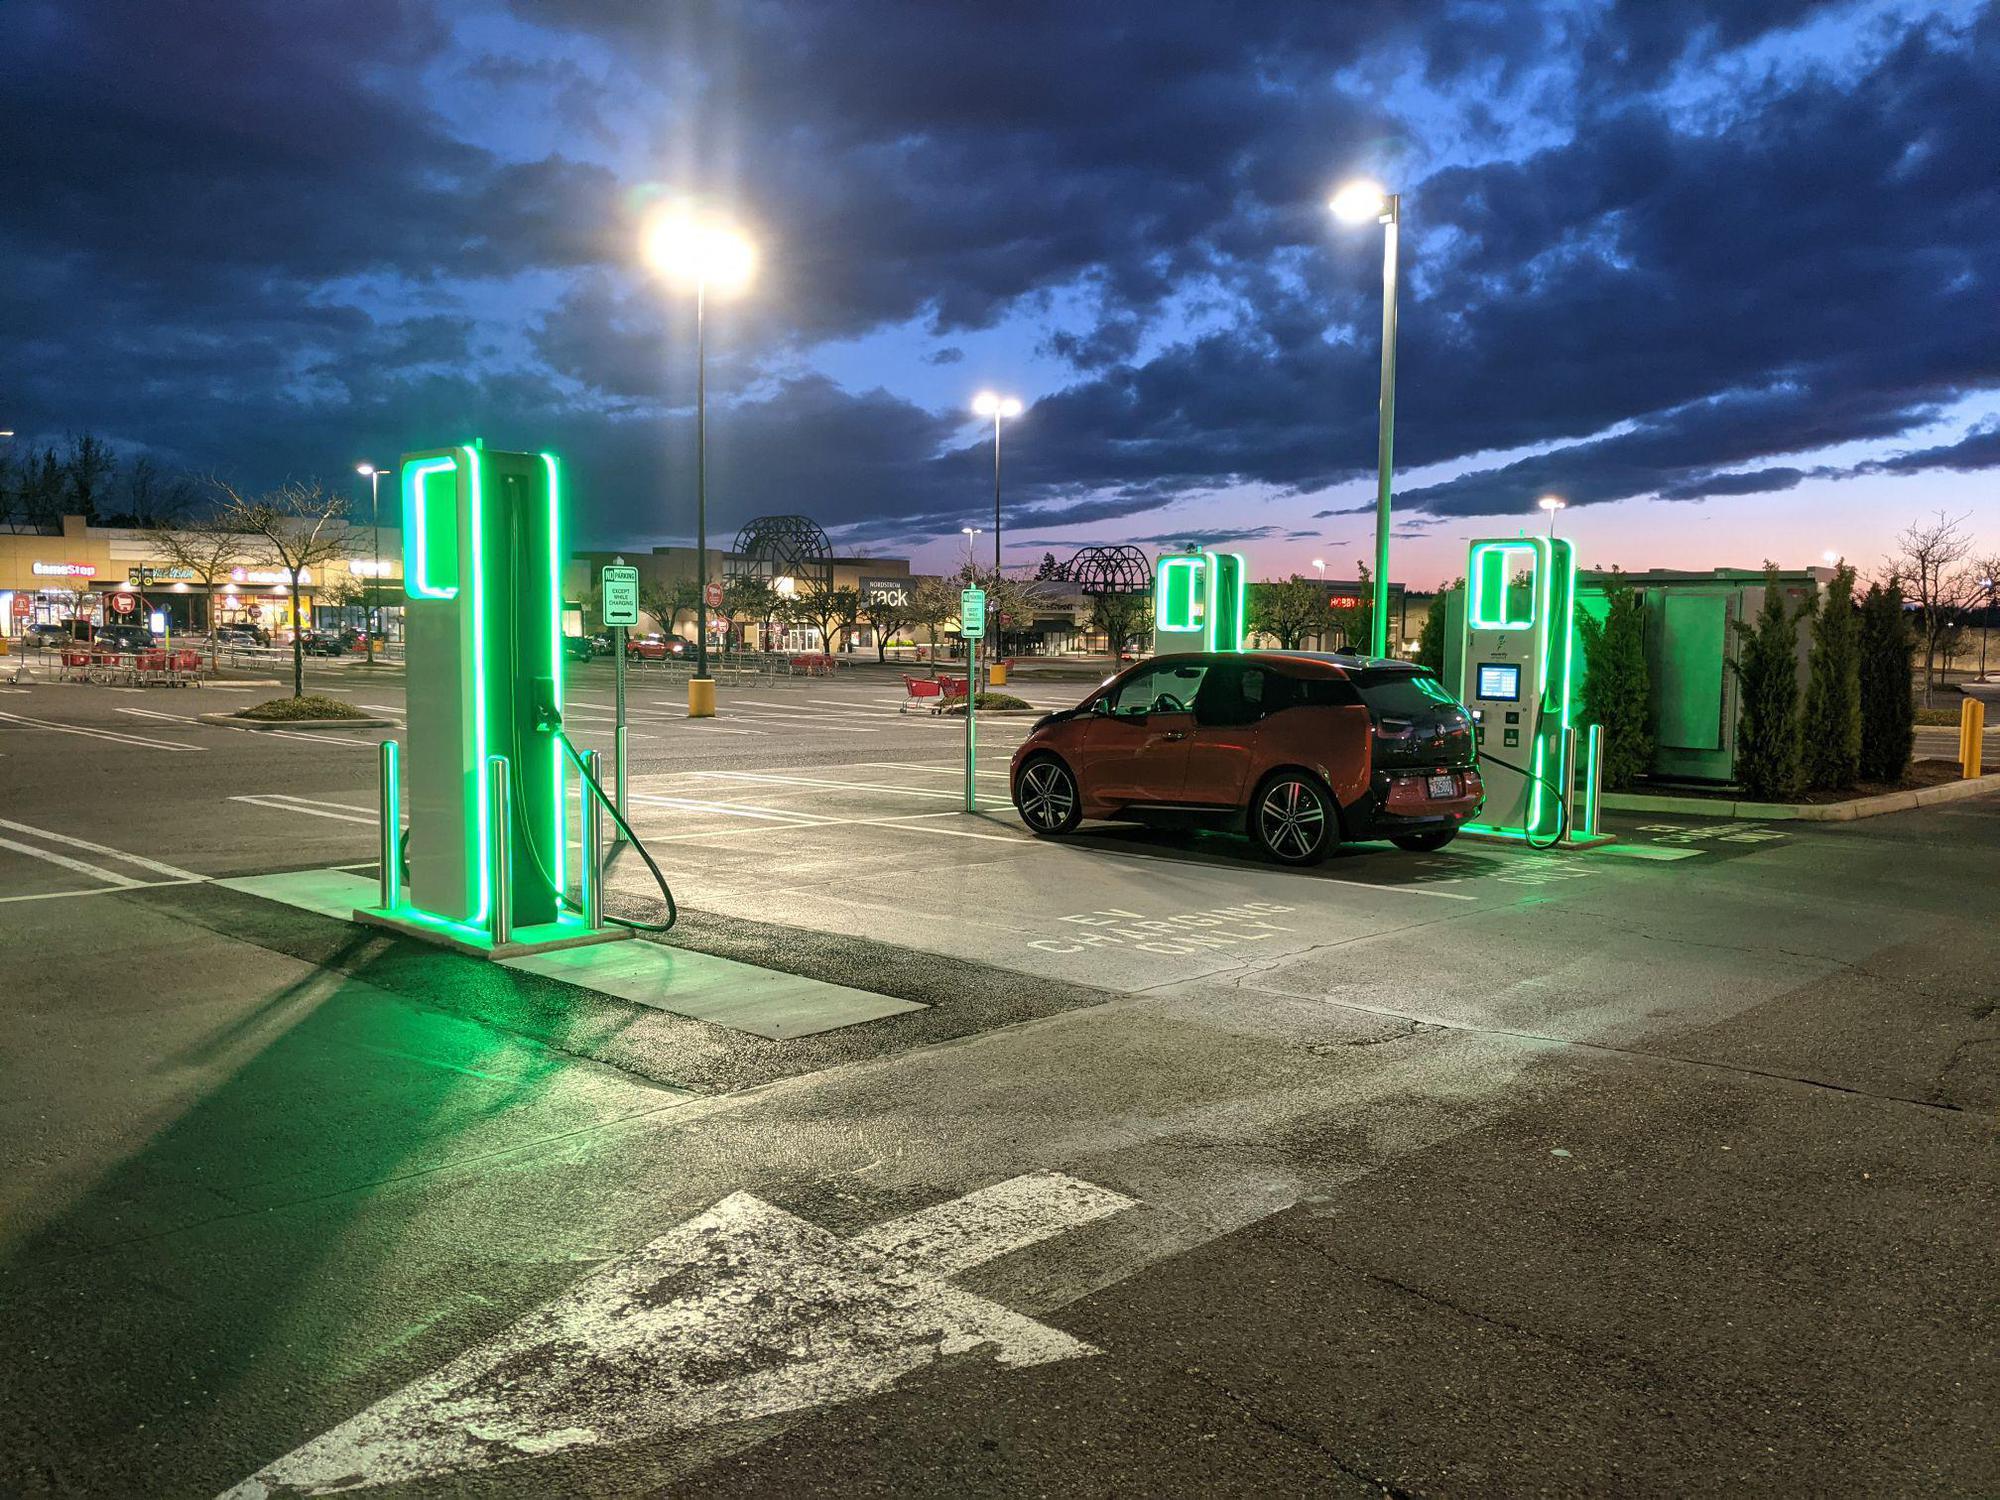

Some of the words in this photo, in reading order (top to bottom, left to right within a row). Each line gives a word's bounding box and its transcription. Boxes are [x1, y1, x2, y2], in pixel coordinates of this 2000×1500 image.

[32, 562, 96, 577] GameStop
[605, 570, 614, 580] NO
[614, 572, 635, 580] PARKING
[870, 589, 908, 607] rack
[1330, 598, 1355, 608] HOBBY
[1056, 908, 1146, 926] EV
[1027, 902, 1297, 953] CHARGING
[1135, 921, 1297, 955] ONLY
